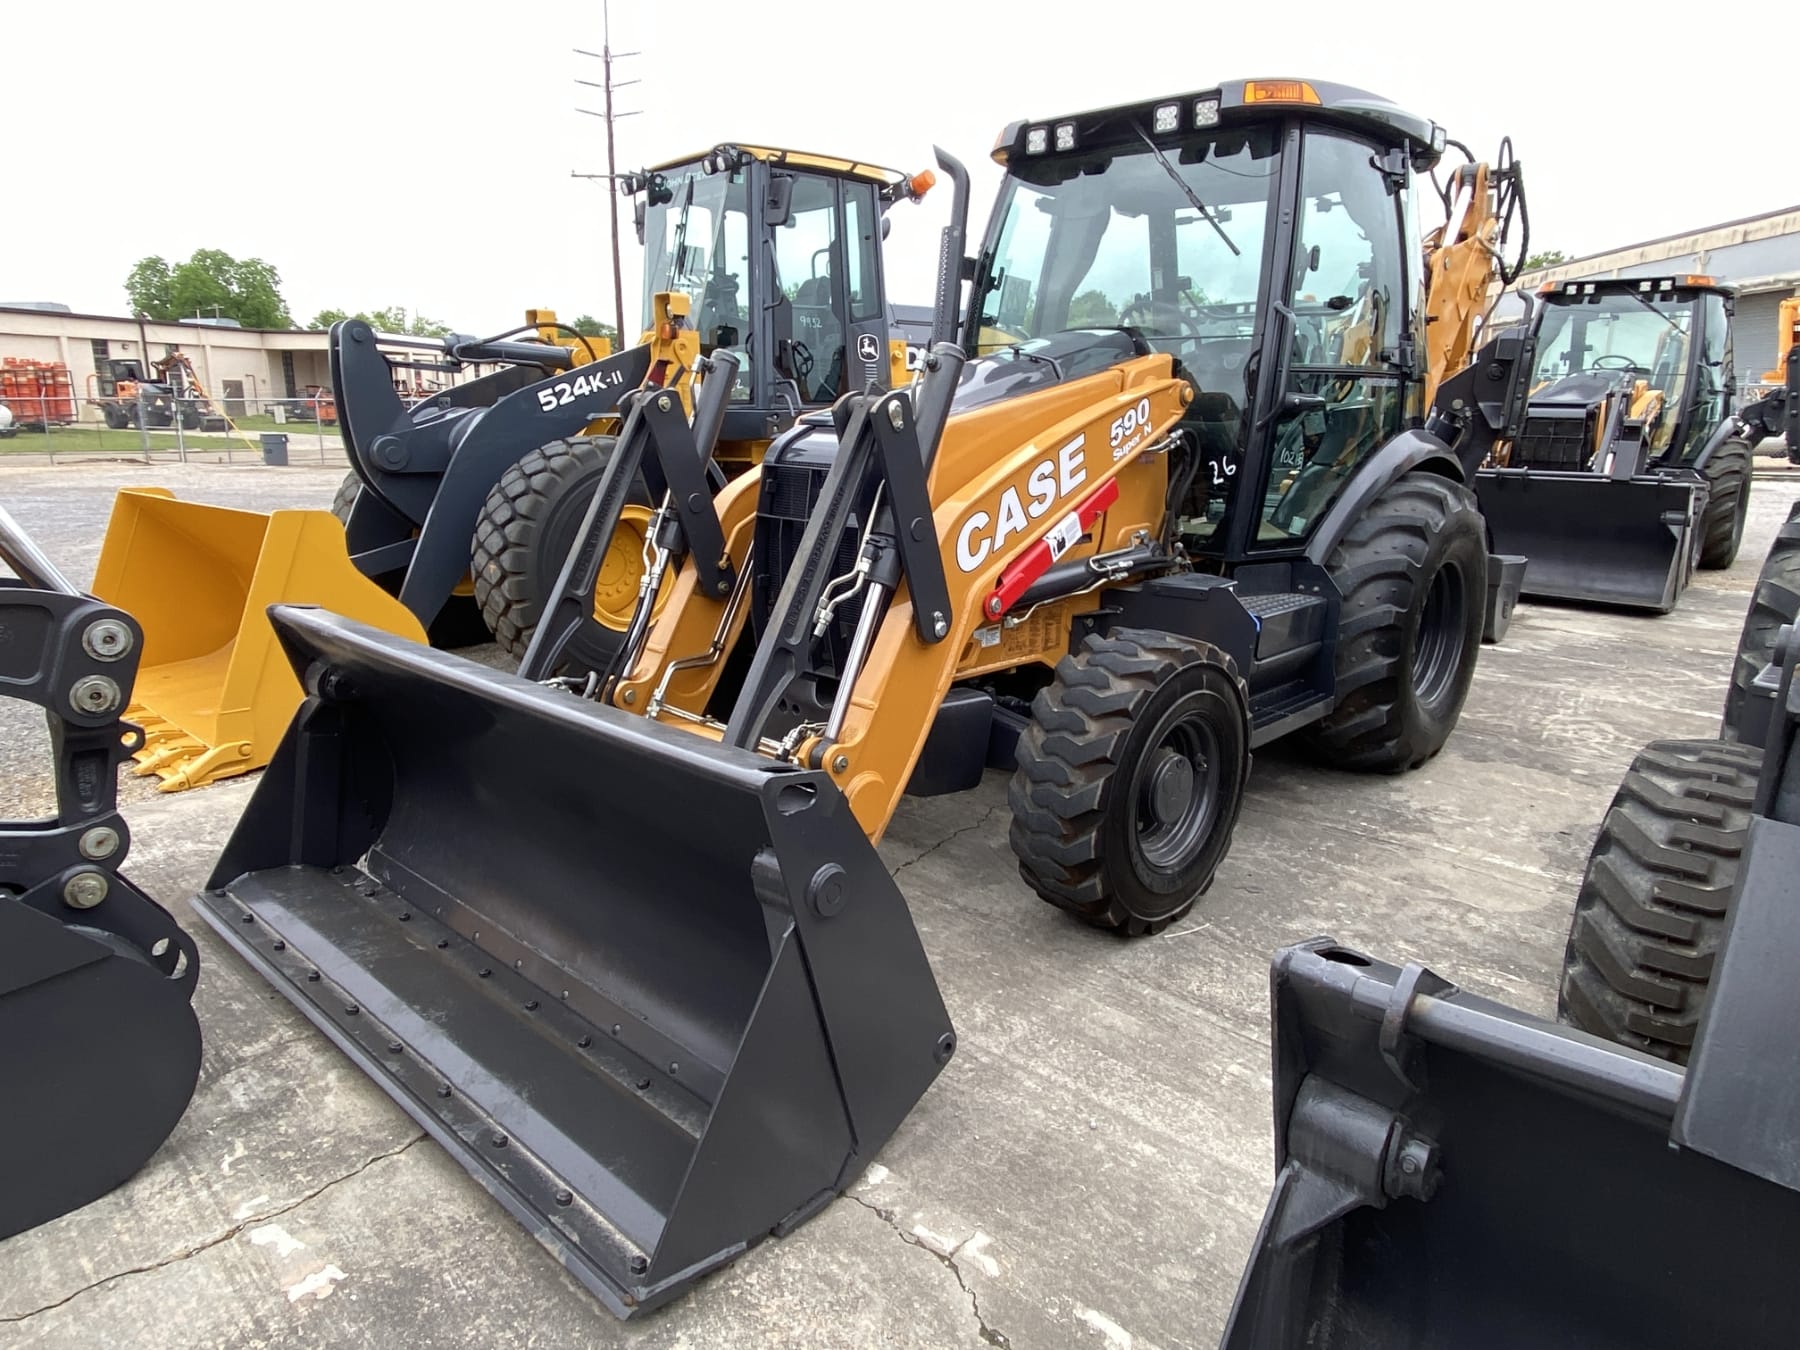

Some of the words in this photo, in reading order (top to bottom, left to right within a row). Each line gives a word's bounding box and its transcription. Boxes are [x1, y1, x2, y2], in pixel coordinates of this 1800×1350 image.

[1109, 397, 1151, 448] 590
[1112, 432, 1142, 462] Super
[1143, 421, 1153, 437] N
[1208, 455, 1237, 485] 26
[955, 431, 1088, 574] CASE
